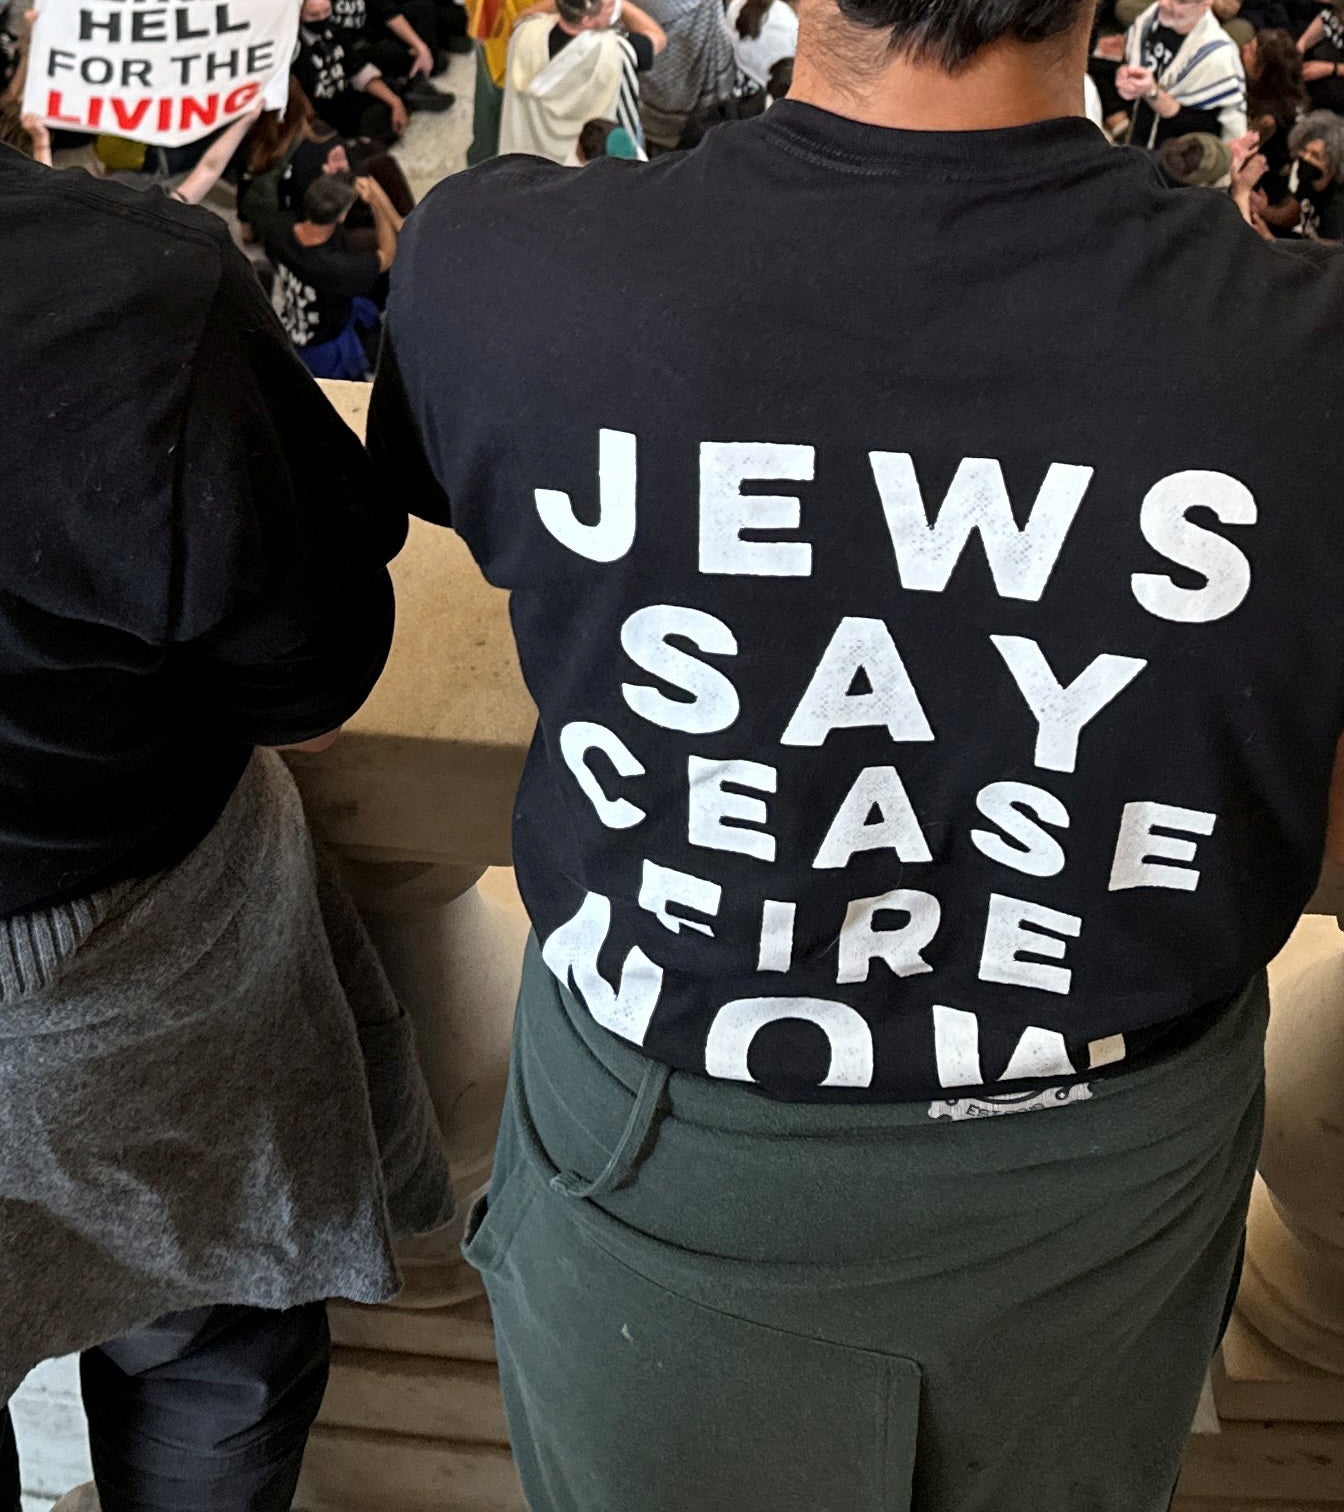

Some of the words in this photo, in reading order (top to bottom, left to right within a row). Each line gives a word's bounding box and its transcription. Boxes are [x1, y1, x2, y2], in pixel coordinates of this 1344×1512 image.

[46, 47, 153, 87] FOR
[169, 40, 276, 85] THE
[78, 2, 251, 43] HELL
[45, 80, 264, 133] LIVING
[533, 427, 1258, 624] JEWS
[620, 602, 1147, 773] SAY
[559, 719, 1217, 878] CEASE
[636, 859, 1082, 995] FIRE
